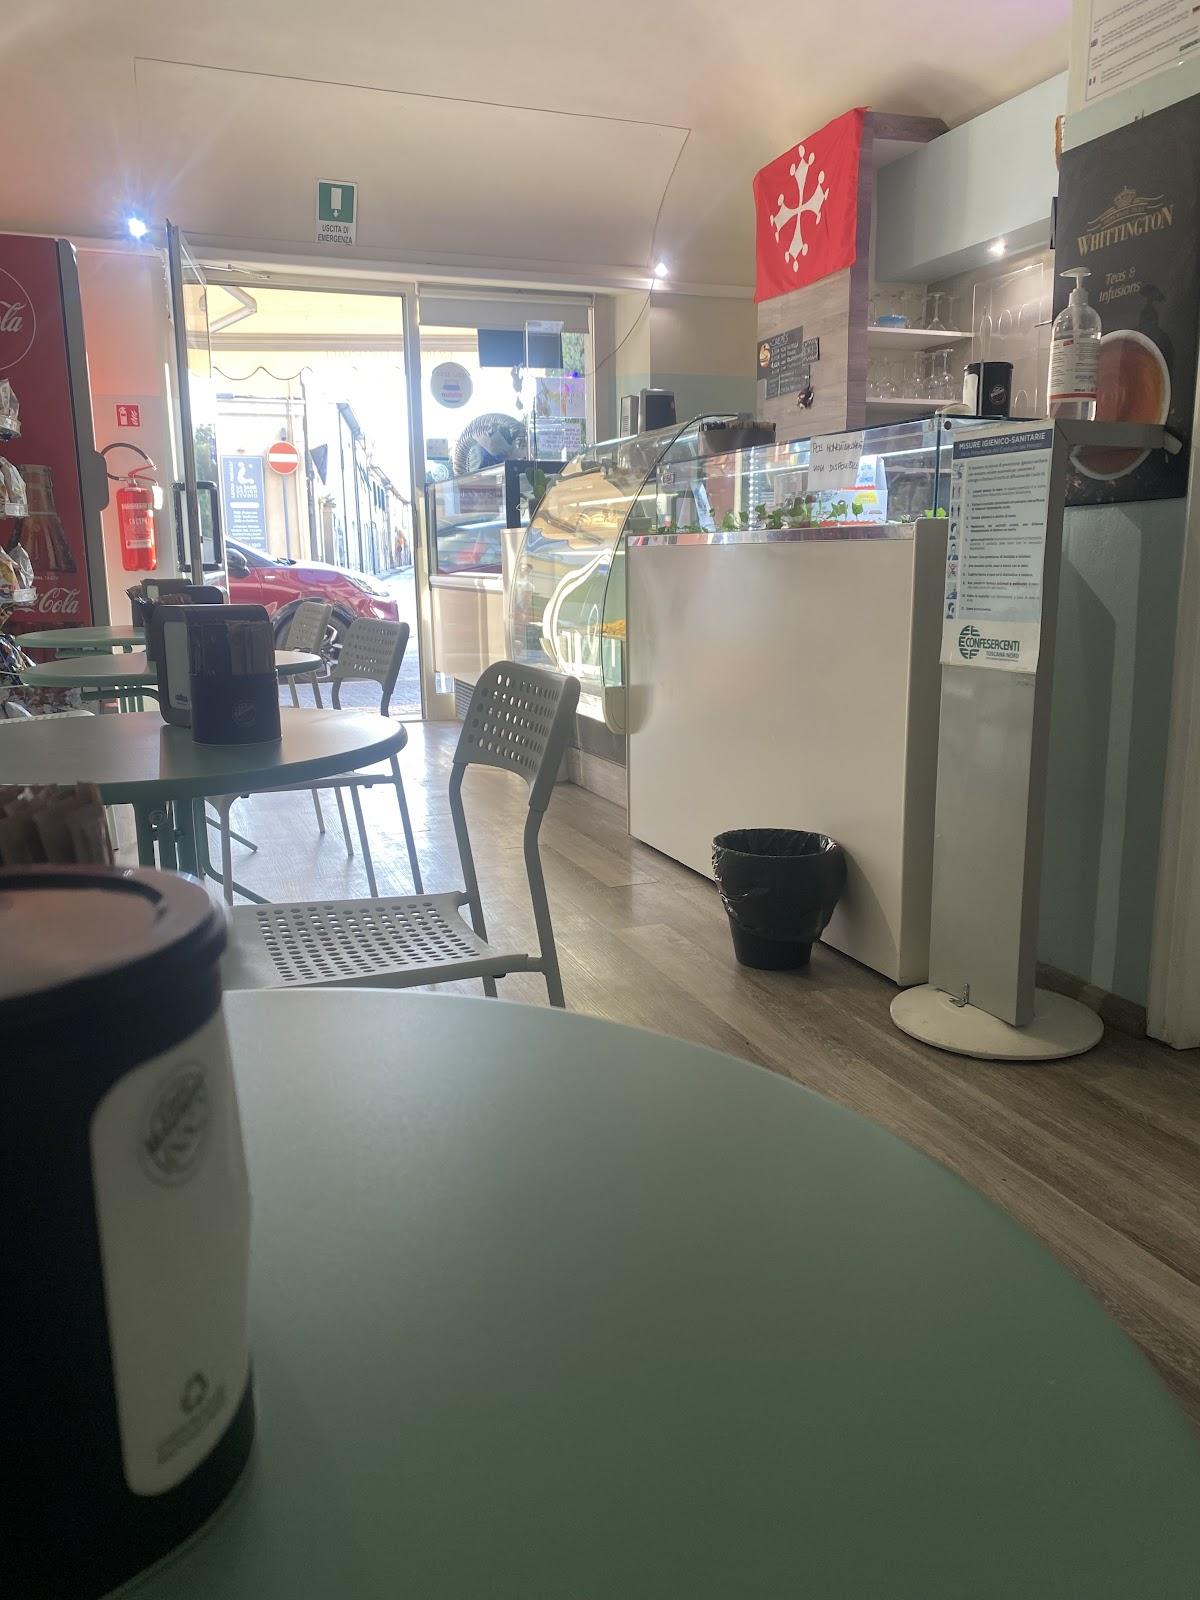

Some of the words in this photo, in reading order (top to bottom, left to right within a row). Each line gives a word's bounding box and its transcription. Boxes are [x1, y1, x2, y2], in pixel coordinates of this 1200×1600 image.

[322, 224, 341, 233] USCITA
[342, 226, 349, 234] DI
[1077, 206, 1175, 257] WHITTINGTON
[317, 233, 353, 245] EMERGENZA
[1105, 271, 1126, 285] Teas
[1099, 281, 1142, 303] Infusions
[959, 440, 981, 450] MISURE
[981, 432, 1046, 448] IGIENICO-SANITARIE
[965, 637, 1020, 652] CONFESERCENTI
